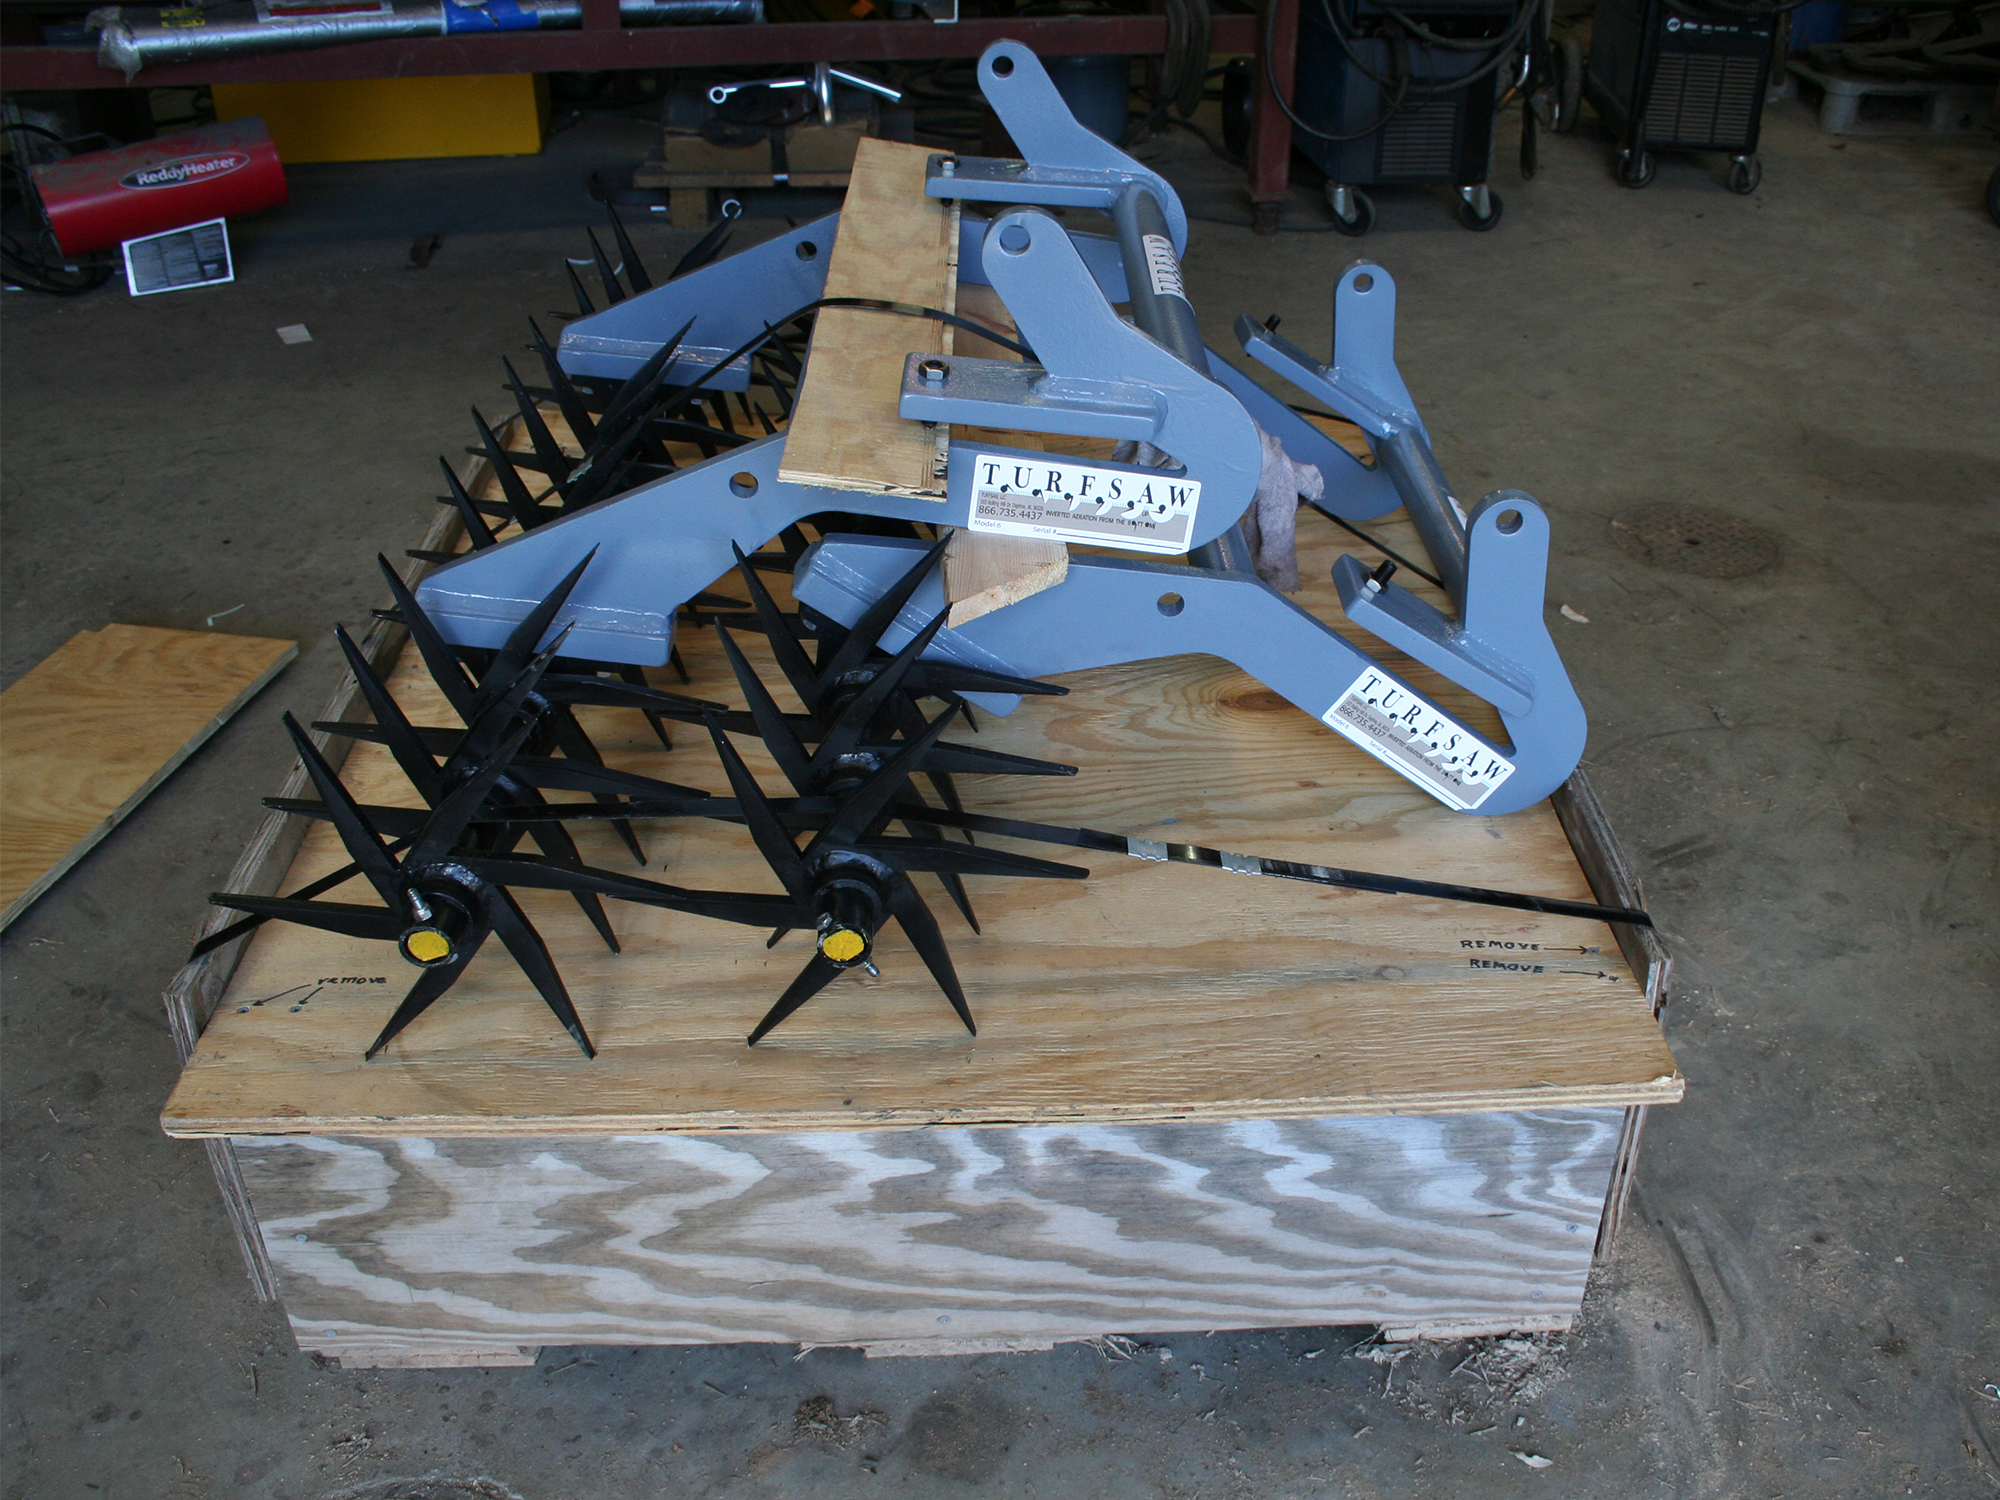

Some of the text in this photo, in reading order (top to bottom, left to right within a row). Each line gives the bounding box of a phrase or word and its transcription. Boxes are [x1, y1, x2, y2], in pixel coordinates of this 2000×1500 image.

[136, 158, 235, 185] ReddyHeater
[978, 505, 1042, 520] 866.735.4437
[1045, 510, 1070, 518] INVERTED
[1071, 513, 1097, 521] AERATION
[974, 519, 995, 527] Model
[1032, 525, 1051, 533] Serial
[1328, 713, 1346, 726] Model
[1338, 705, 1386, 738] 866.735.4437
[1368, 741, 1383, 751] Serial
[1387, 733, 1406, 747] INVERTED
[1422, 757, 1434, 766] FROM
[1460, 940, 1540, 951] REMOVE
[1470, 959, 1544, 973] REMOVE
[317, 977, 388, 985] remove
